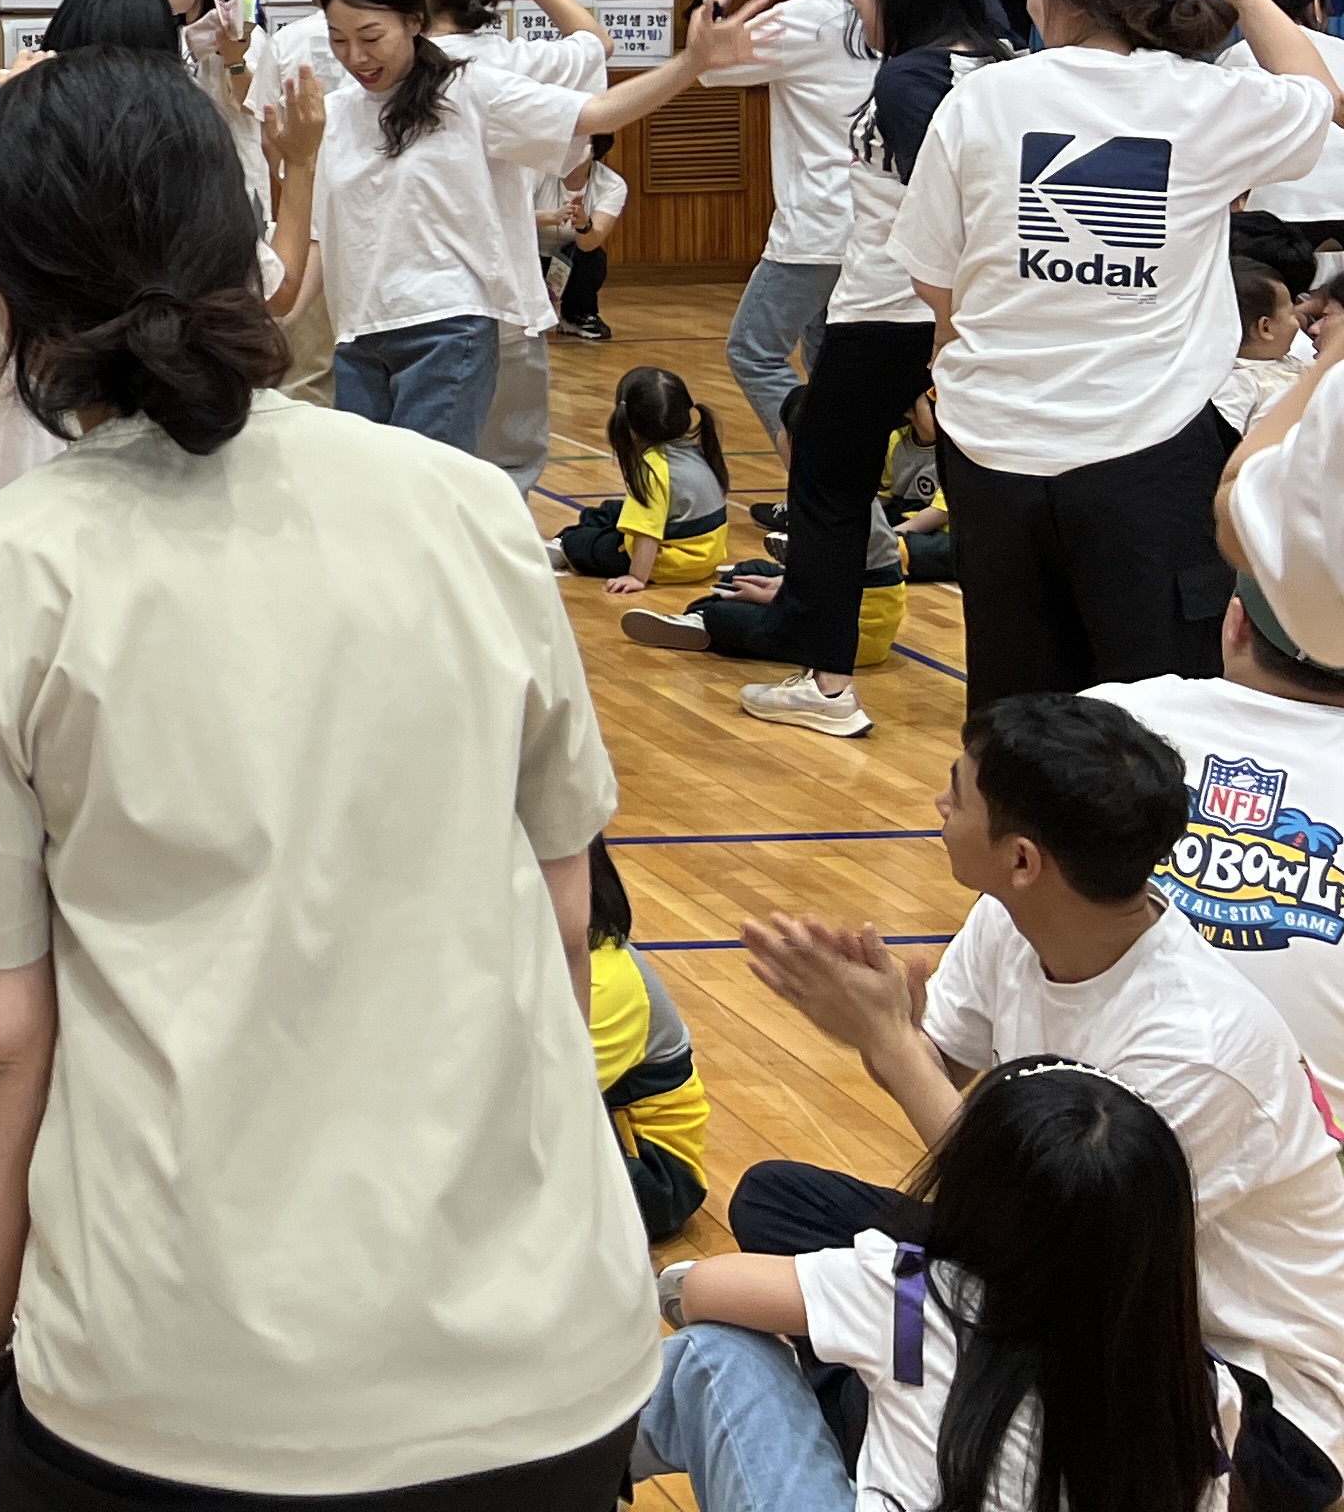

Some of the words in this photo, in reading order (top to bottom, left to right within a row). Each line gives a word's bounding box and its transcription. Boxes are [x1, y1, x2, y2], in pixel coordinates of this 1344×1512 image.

[603, 14, 641, 27] 창의샘
[647, 14, 668, 28] 3반
[1019, 247, 1159, 288] Kodak
[1206, 785, 1266, 823] NFL
[1191, 899, 1274, 922] ALL-STAR
[1284, 910, 1338, 937] GAME
[1197, 923, 1264, 946] WAII
